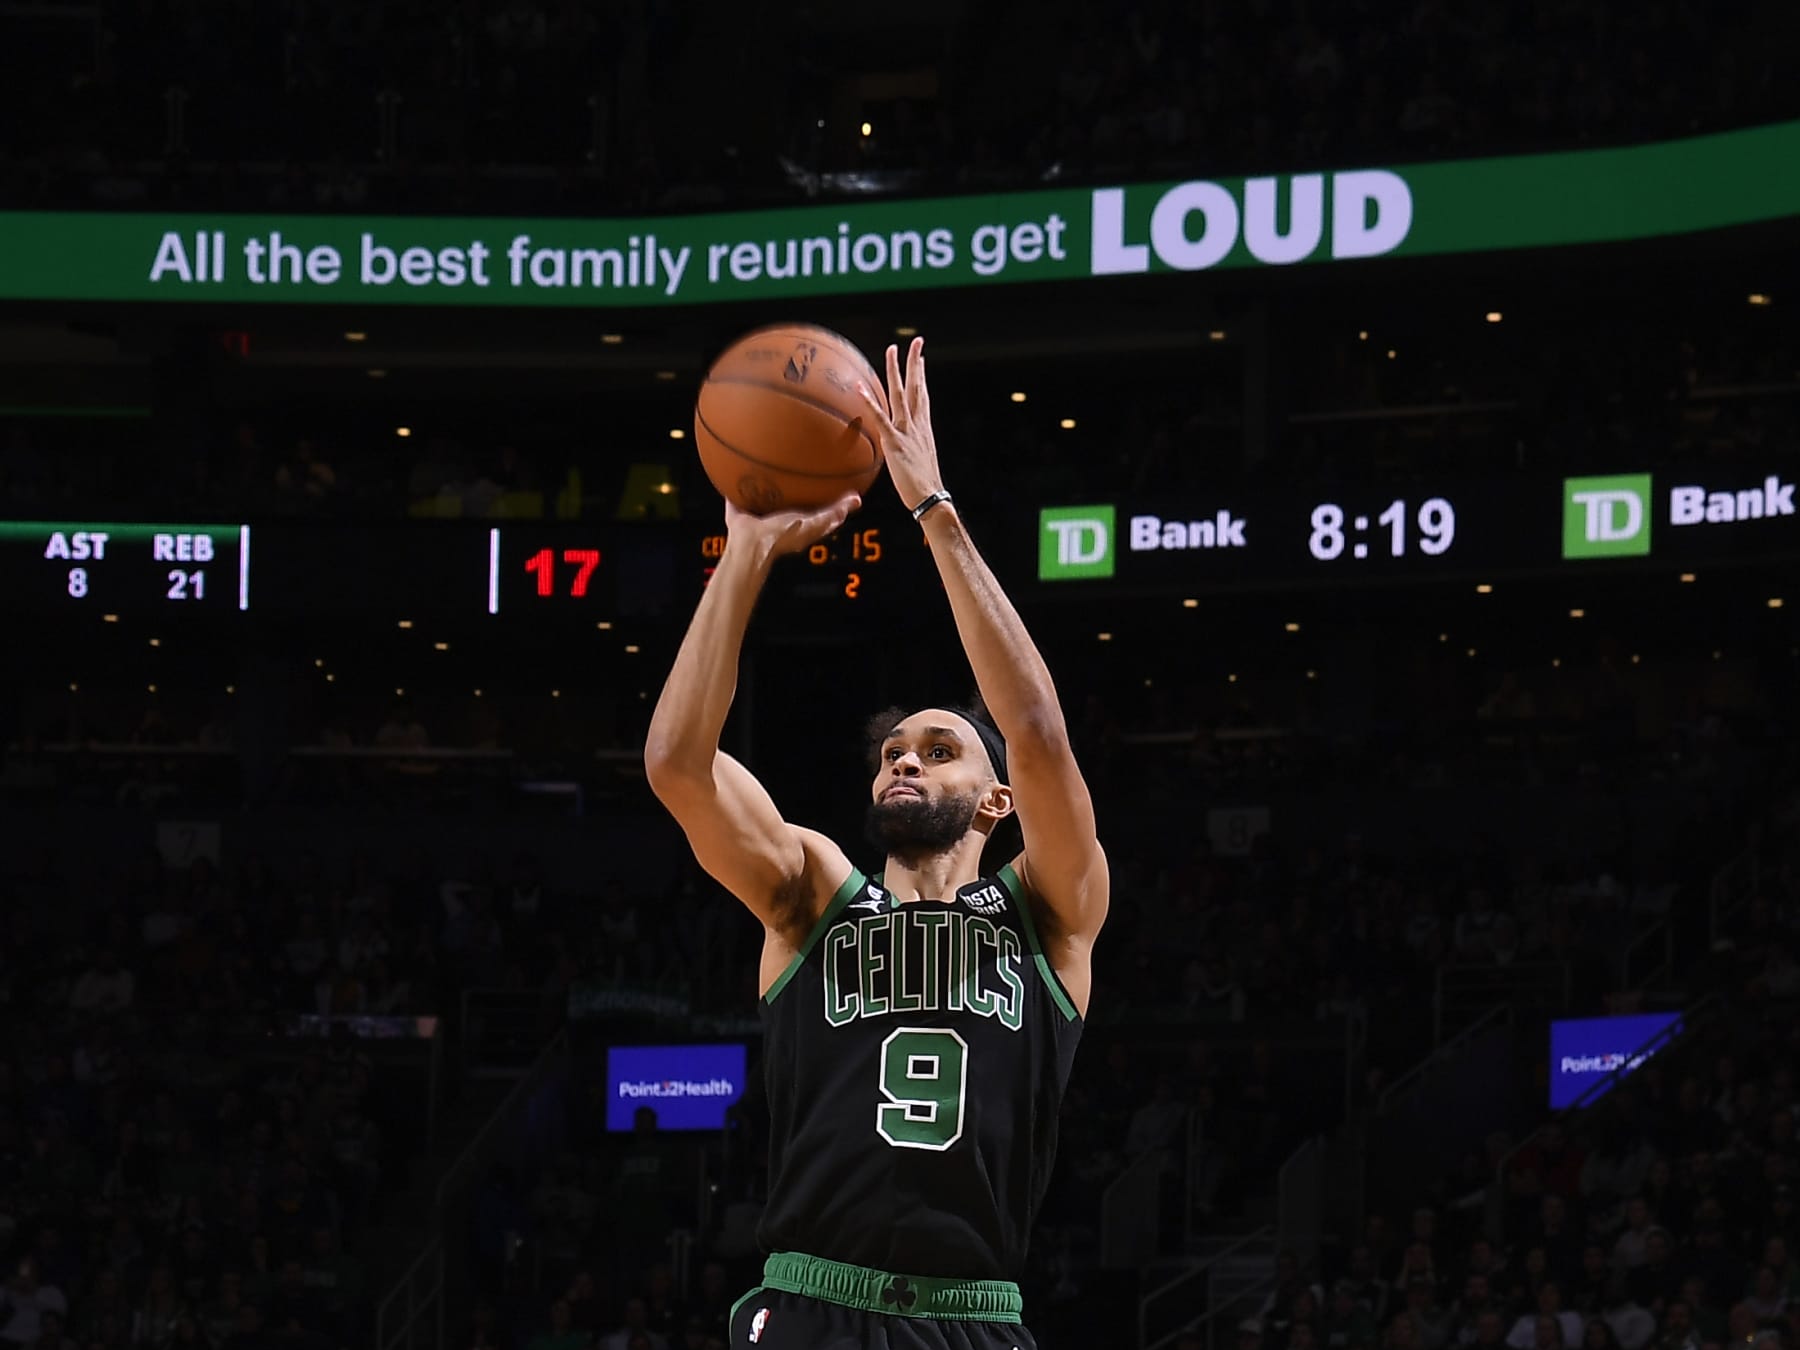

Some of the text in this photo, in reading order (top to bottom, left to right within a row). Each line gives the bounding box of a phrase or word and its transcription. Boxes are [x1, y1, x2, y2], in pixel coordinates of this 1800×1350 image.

[150, 169, 1414, 295] All the best family reunions get LOUD
[1047, 510, 1247, 566] TD Bank
[1308, 497, 1456, 560] 8:19
[1572, 476, 1796, 543] TD Bank
[45, 532, 214, 562] AST REB
[524, 549, 600, 597] 17
[68, 568, 205, 599] 8 21
[844, 572, 861, 599] 2
[824, 910, 1025, 1031] CELTICS
[876, 1027, 968, 1151] 9
